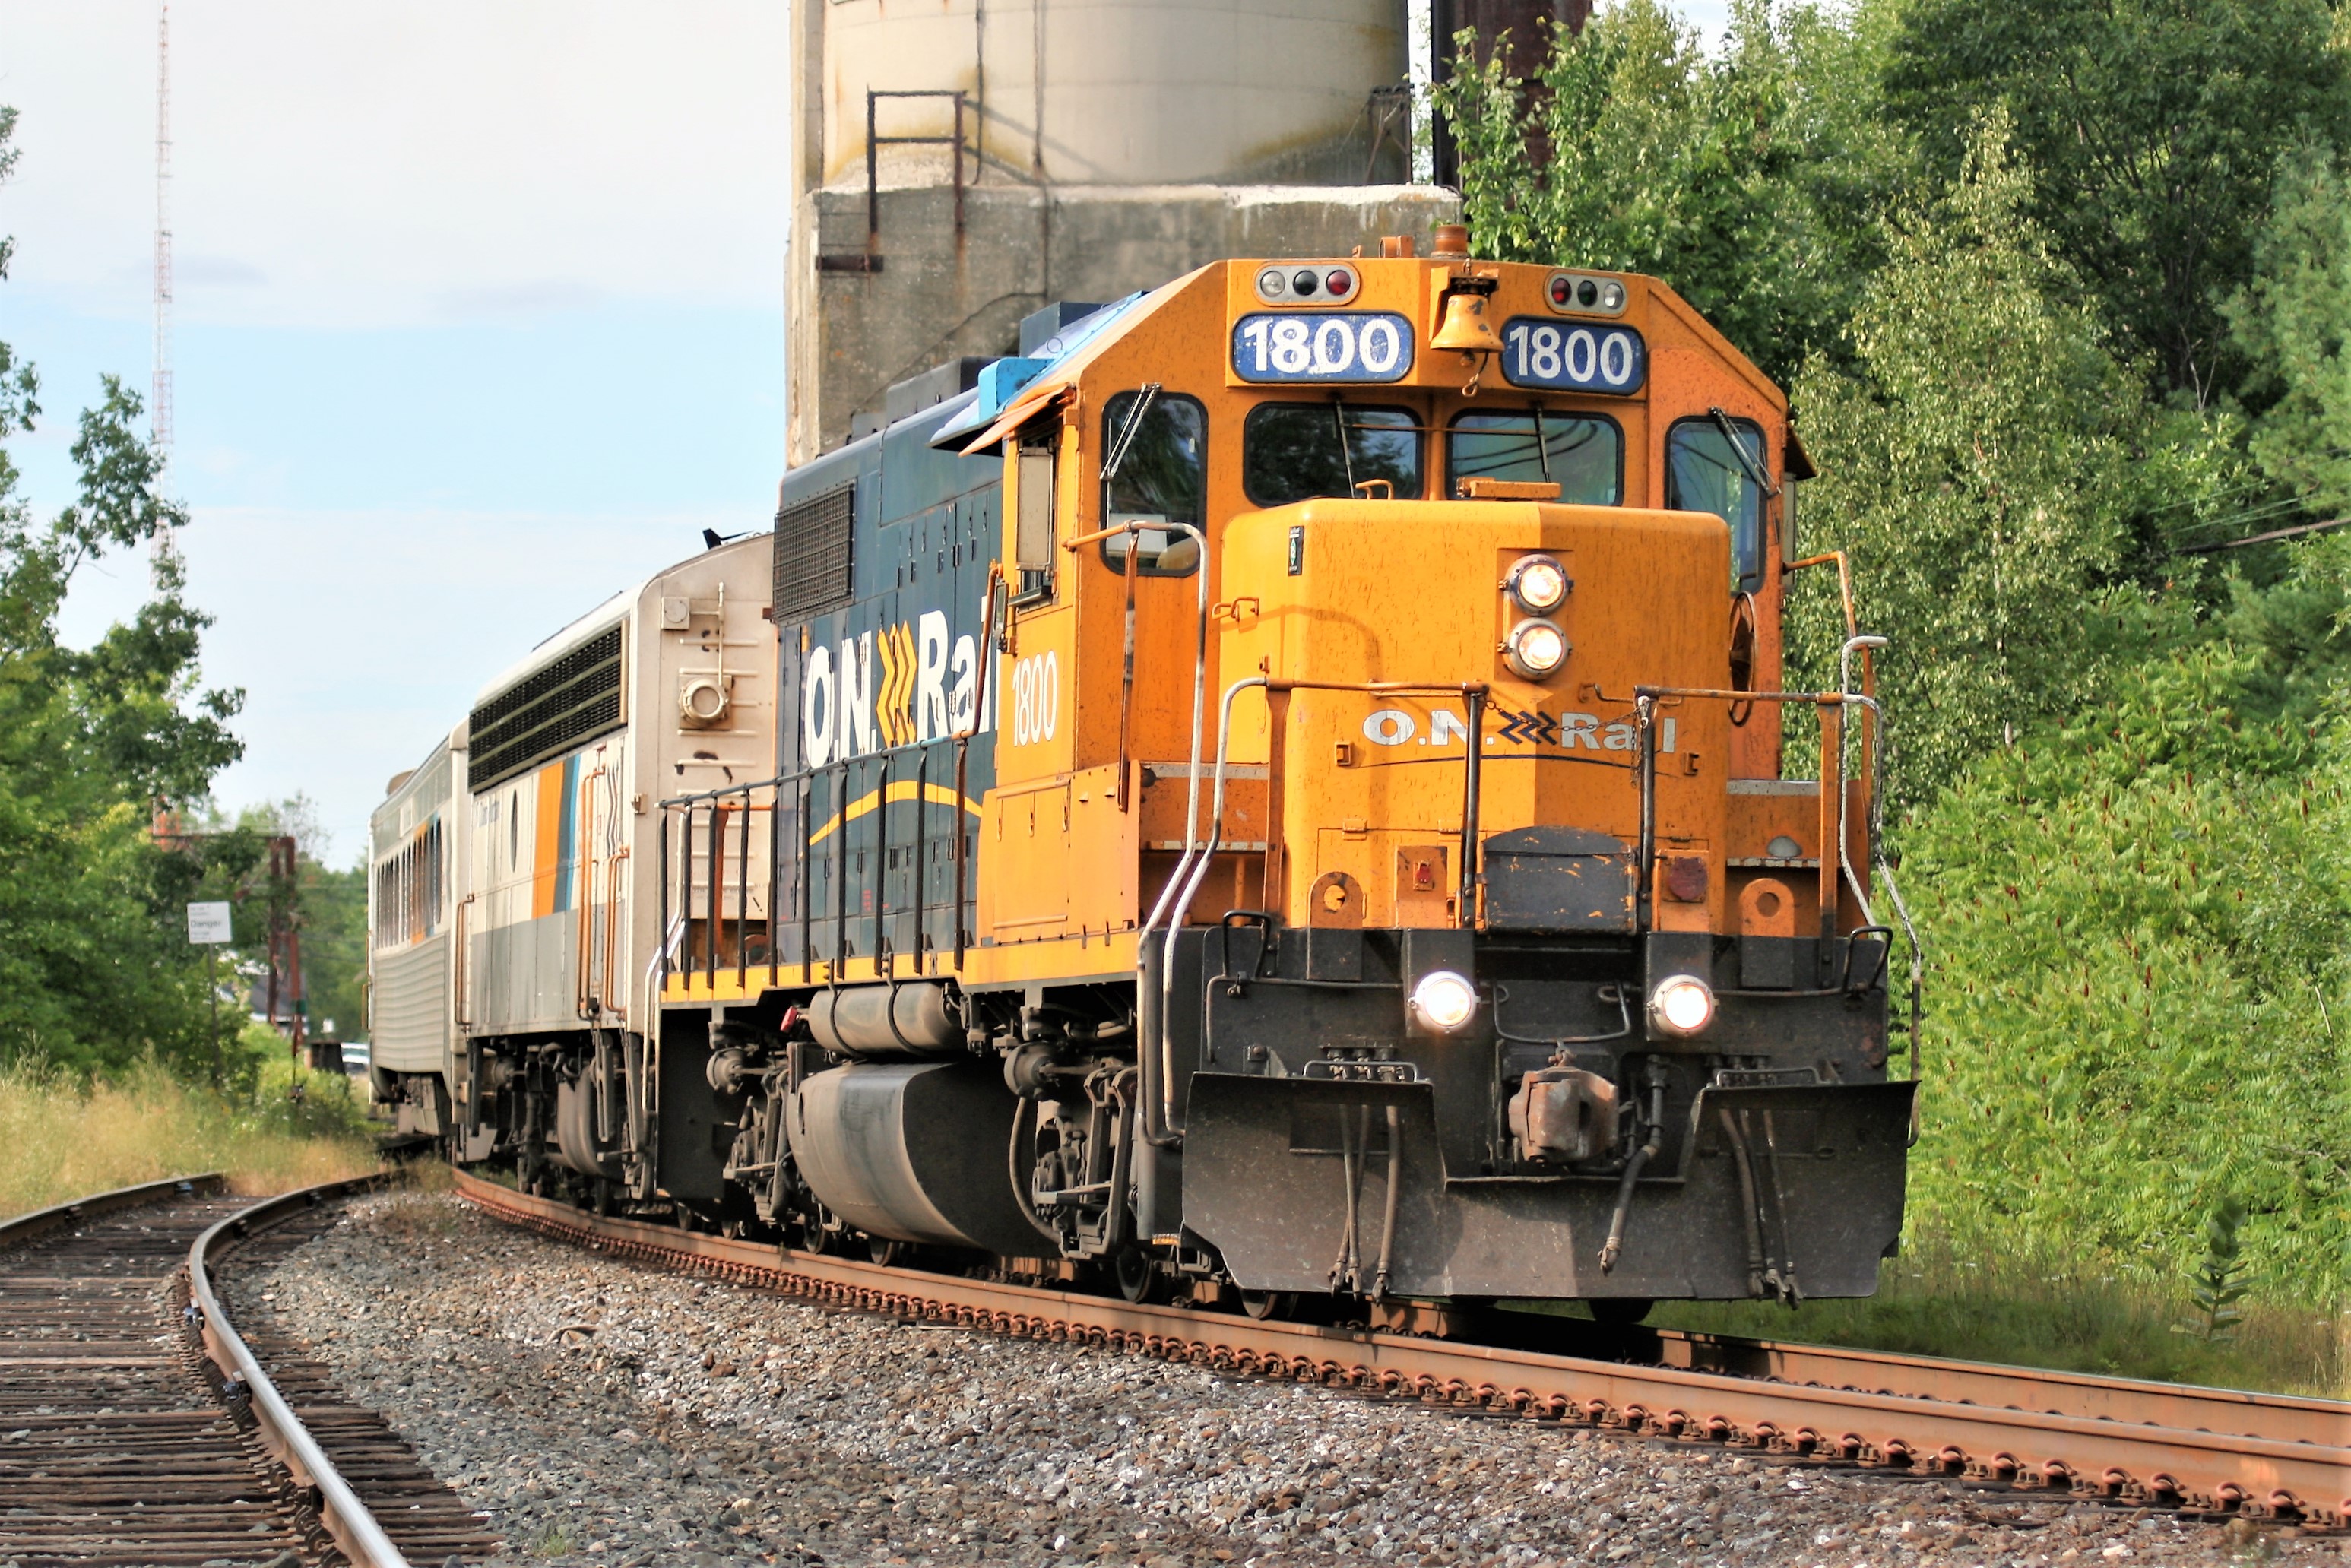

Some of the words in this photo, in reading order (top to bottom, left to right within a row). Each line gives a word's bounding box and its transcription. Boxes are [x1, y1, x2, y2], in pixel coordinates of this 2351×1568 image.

[1243, 318, 1400, 375] 1800
[1508, 325, 1633, 385] 1800
[804, 630, 877, 769] O.N.
[1012, 650, 1057, 747] 1800
[1560, 712, 1677, 753] Ral
[190, 920, 222, 929] Danger
